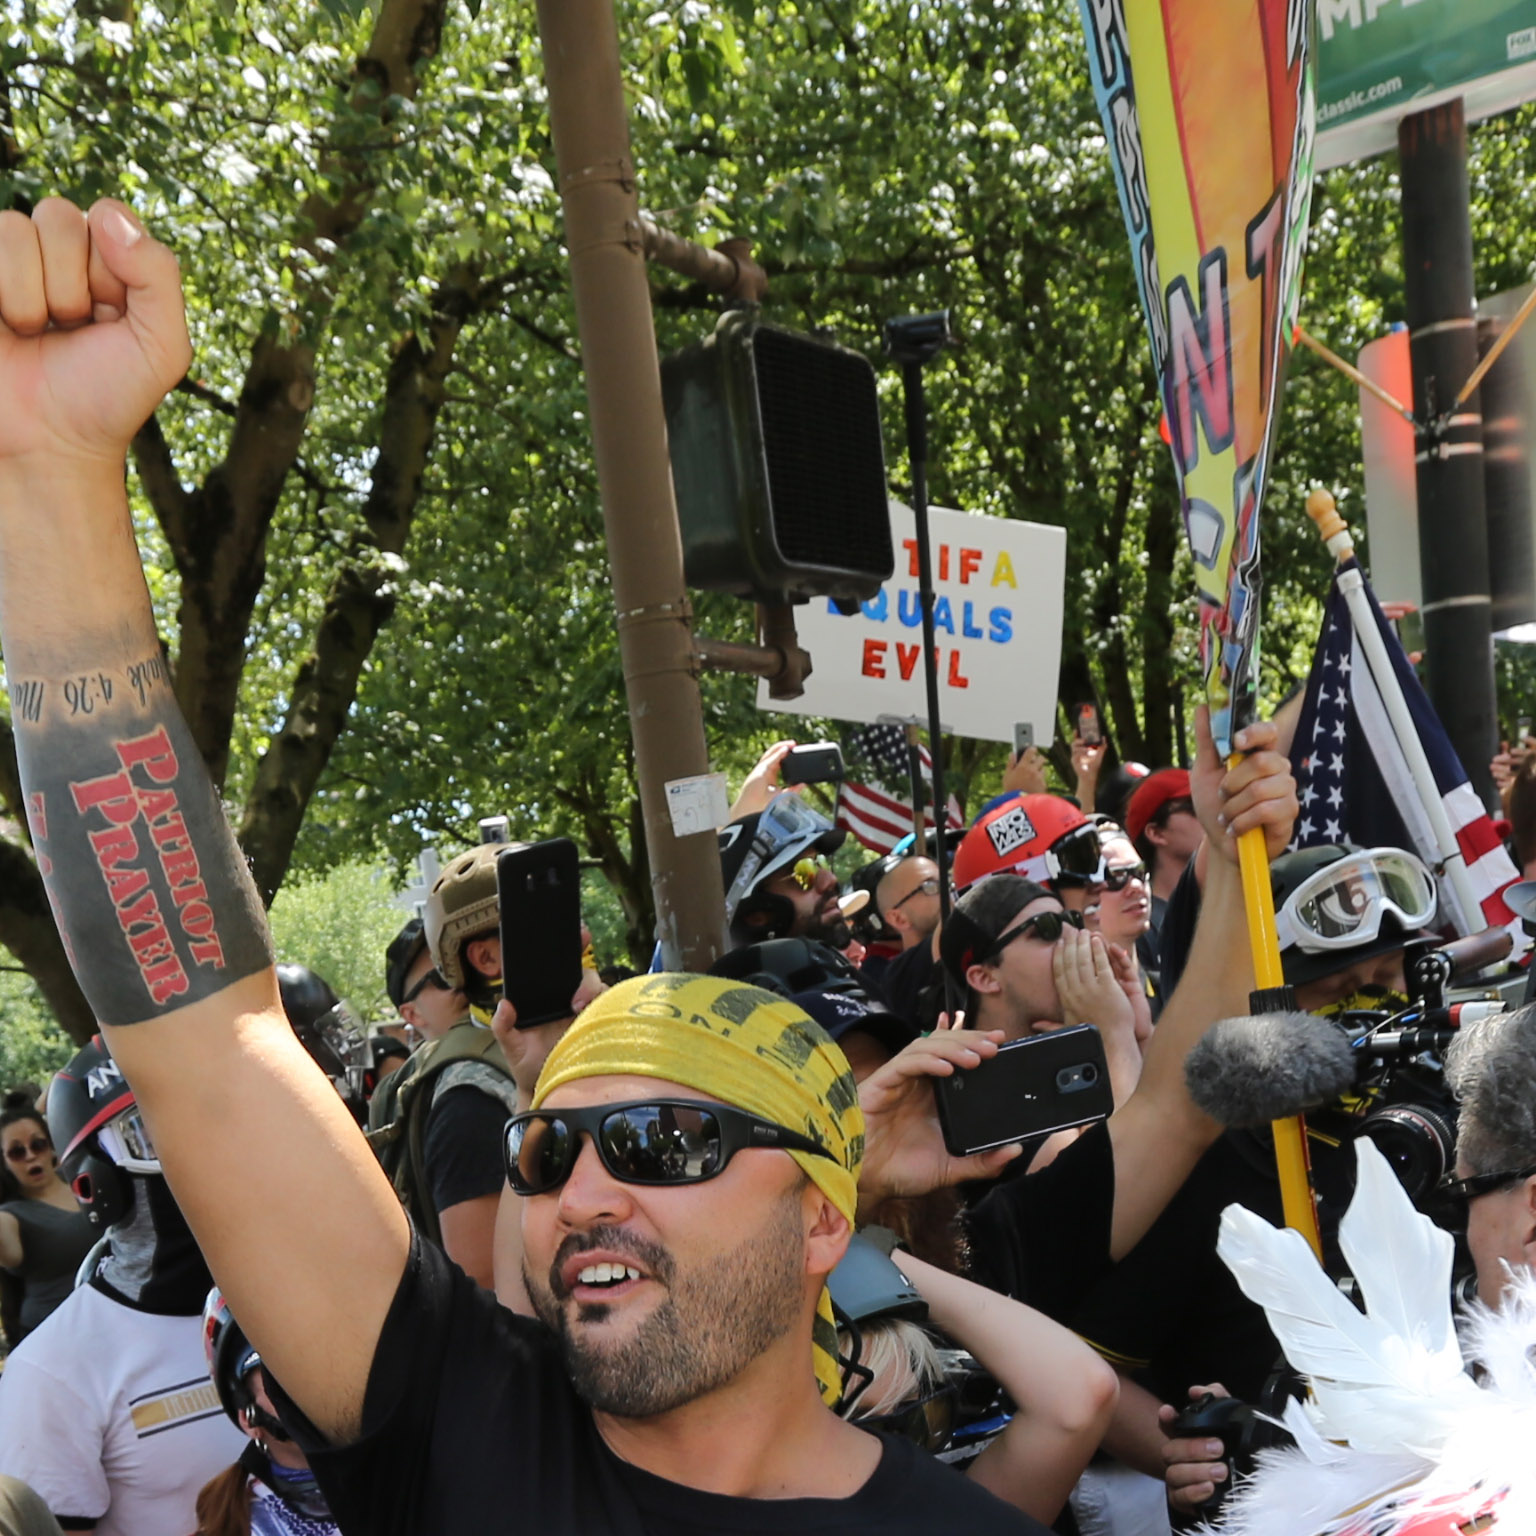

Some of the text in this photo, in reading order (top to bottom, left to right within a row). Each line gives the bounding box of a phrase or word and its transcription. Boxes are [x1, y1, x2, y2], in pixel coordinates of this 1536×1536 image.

[827, 586, 1013, 644] QUALS
[68, 769, 190, 1005] PRAYER
[113, 724, 226, 970] PATRIOT
